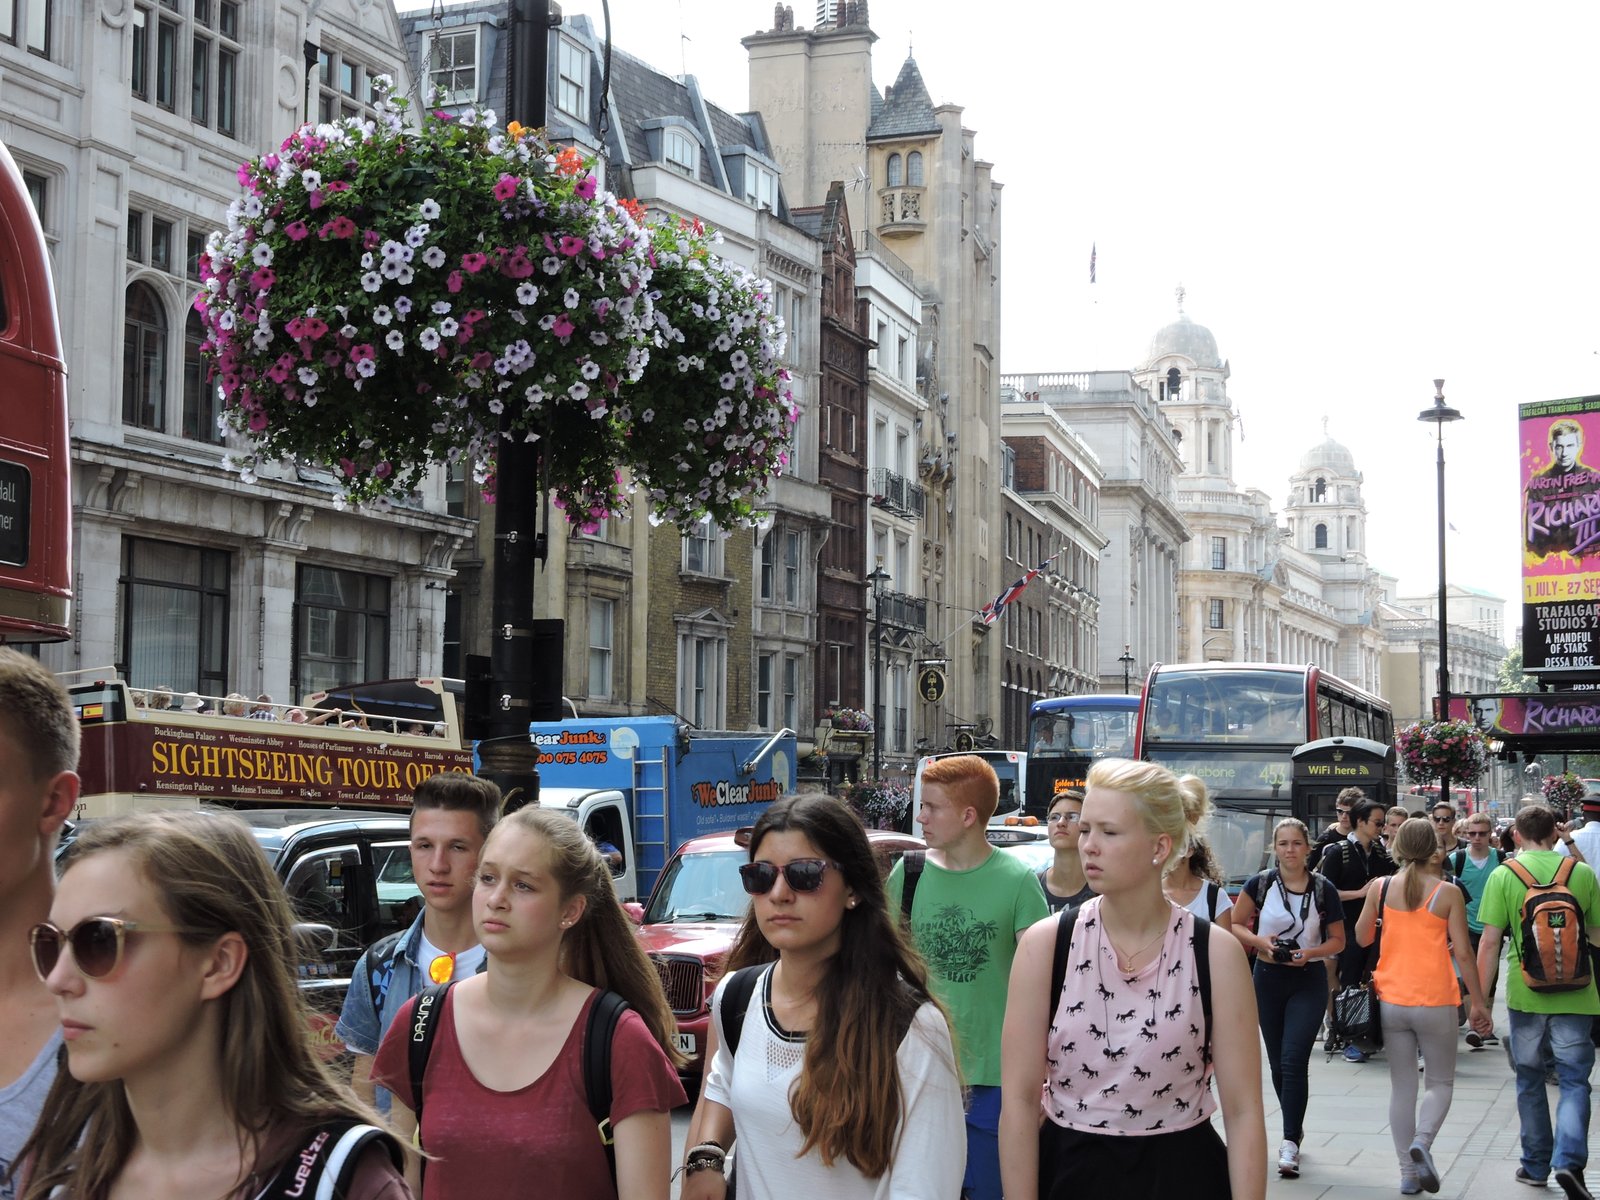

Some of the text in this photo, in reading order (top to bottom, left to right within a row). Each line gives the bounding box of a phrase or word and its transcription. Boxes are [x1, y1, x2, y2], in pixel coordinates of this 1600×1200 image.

[1527, 585, 1532, 597] 1
[1567, 582, 1581, 594] 27
[1535, 604, 1600, 618] TRAFALGAR
[1538, 616, 1598, 631] STUDIOS 2
[1545, 632, 1592, 644] A HANDFUL
[1550, 642, 1588, 654] OF STARS
[1545, 656, 1594, 668] DESSA ROSE
[154, 727, 194, 741] Buckingham
[196, 732, 216, 742] Palace
[229, 734, 265, 745] Westminster
[267, 737, 284, 747] Abbey
[298, 740, 317, 749] Houses
[318, 742, 324, 750] of
[325, 742, 354, 752] Parliament
[366, 746, 373, 754] St
[389, 748, 413, 758] Cathedral
[424, 751, 443, 760] Harrods
[454, 754, 470, 763] Oxford
[537, 751, 607, 764] 00 075 4075
[152, 741, 433, 790] SIGHTSEEING TOUR OF
[1308, 765, 1357, 775] WiFi here
[1259, 764, 1286, 785] 453
[156, 780, 193, 791] Kensington
[194, 782, 215, 792] Palace
[231, 785, 257, 795] Madame
[257, 786, 284, 795] Tussauds
[310, 789, 321, 798] Ben
[338, 791, 354, 799] Tower
[361, 792, 381, 800] London
[691, 778, 784, 808] WeClearJunk
[696, 816, 704, 825] Old
[413, 995, 434, 1042] DAKINE
